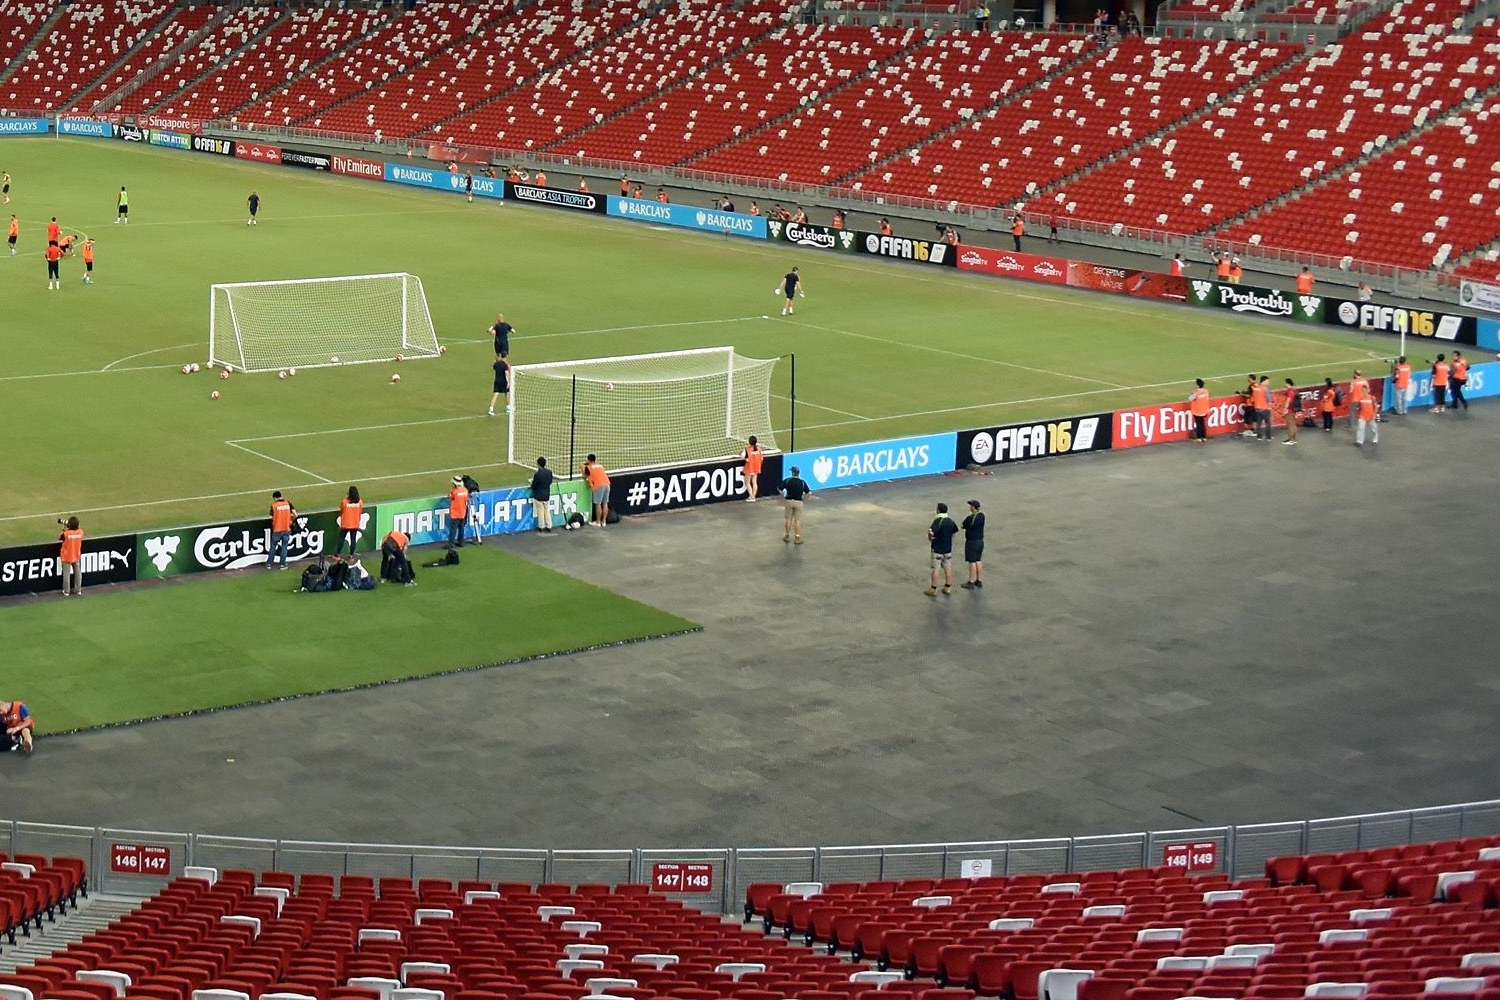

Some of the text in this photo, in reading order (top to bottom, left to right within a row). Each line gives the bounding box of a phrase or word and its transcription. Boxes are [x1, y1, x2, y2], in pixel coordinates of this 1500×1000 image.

[71, 122, 103, 134] BARCLAYS
[149, 115, 190, 129] Singapore
[120, 126, 142, 141] Probably
[201, 138, 215, 152] FIFA
[333, 157, 346, 173] Fly
[348, 160, 382, 176] Emirates
[400, 168, 433, 183] BARCLAYS
[459, 178, 494, 192] BCLAYS
[518, 188, 587, 205] BARCLAYS ASIA TROPHY
[628, 202, 671, 219] BARCLAYS
[707, 213, 753, 231] BARCLAYS
[785, 222, 836, 248] Carlsberg
[880, 235, 912, 259] FIFA
[912, 240, 929, 261] 16
[1218, 285, 1293, 315] Probably
[1360, 304, 1407, 333] FIFA
[1408, 311, 1434, 337] 16
[1120, 403, 1246, 442] Fly Emates
[996, 425, 1046, 461] FIFA
[1048, 421, 1072, 454] 16
[836, 445, 930, 477] BARCLAYS
[627, 466, 748, 506] #BAT2015
[393, 493, 578, 533] MATH ATTAX
[115, 855, 137, 867] 146
[144, 857, 166, 869] 147
[1166, 855, 1187, 867] 148
[1193, 853, 1213, 864] 149
[657, 874, 680, 886] 147
[686, 875, 709, 886] 148
